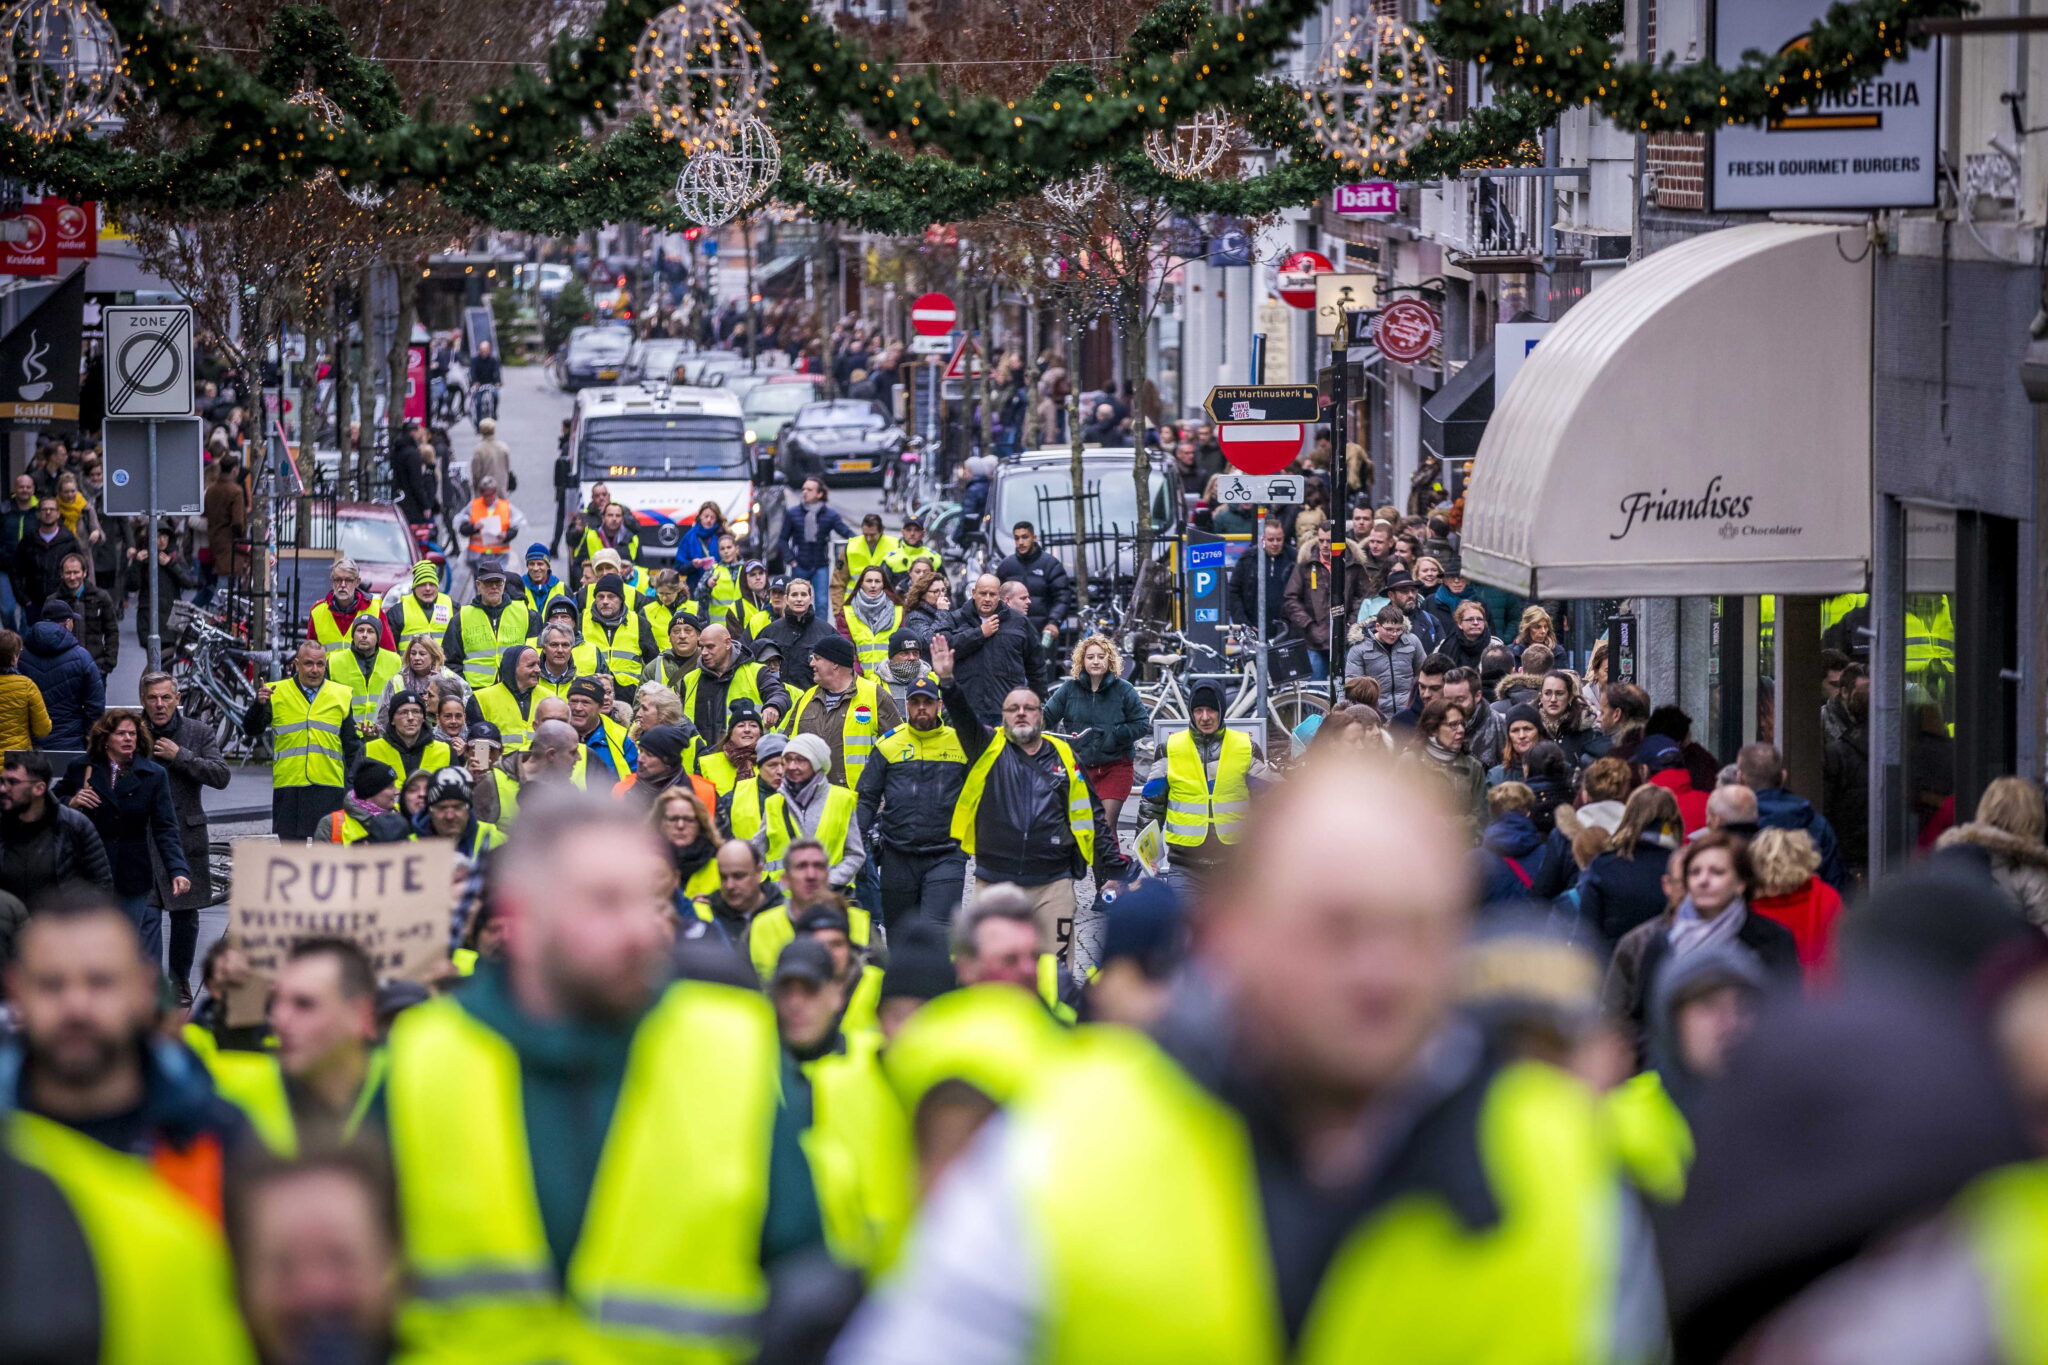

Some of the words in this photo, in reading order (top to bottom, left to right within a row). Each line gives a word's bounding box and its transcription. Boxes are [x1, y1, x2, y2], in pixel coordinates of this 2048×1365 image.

[1728, 161, 1775, 177] FRESH
[1779, 158, 1849, 176] GOURMET
[1853, 157, 1921, 174] BURGERS
[1341, 187, 1392, 207] bart
[6, 255, 46, 265] Kruidvat
[129, 316, 168, 327] ZONE
[1217, 390, 1237, 399] Sint
[1239, 389, 1301, 399] Martinuskerk
[14, 403, 54, 417] kaldi
[1609, 475, 1754, 540] Friandises
[1742, 524, 1803, 536] Chocolatier
[1200, 550, 1222, 560] 27769
[1196, 572, 1211, 593] P
[264, 855, 425, 903] RUTTE
